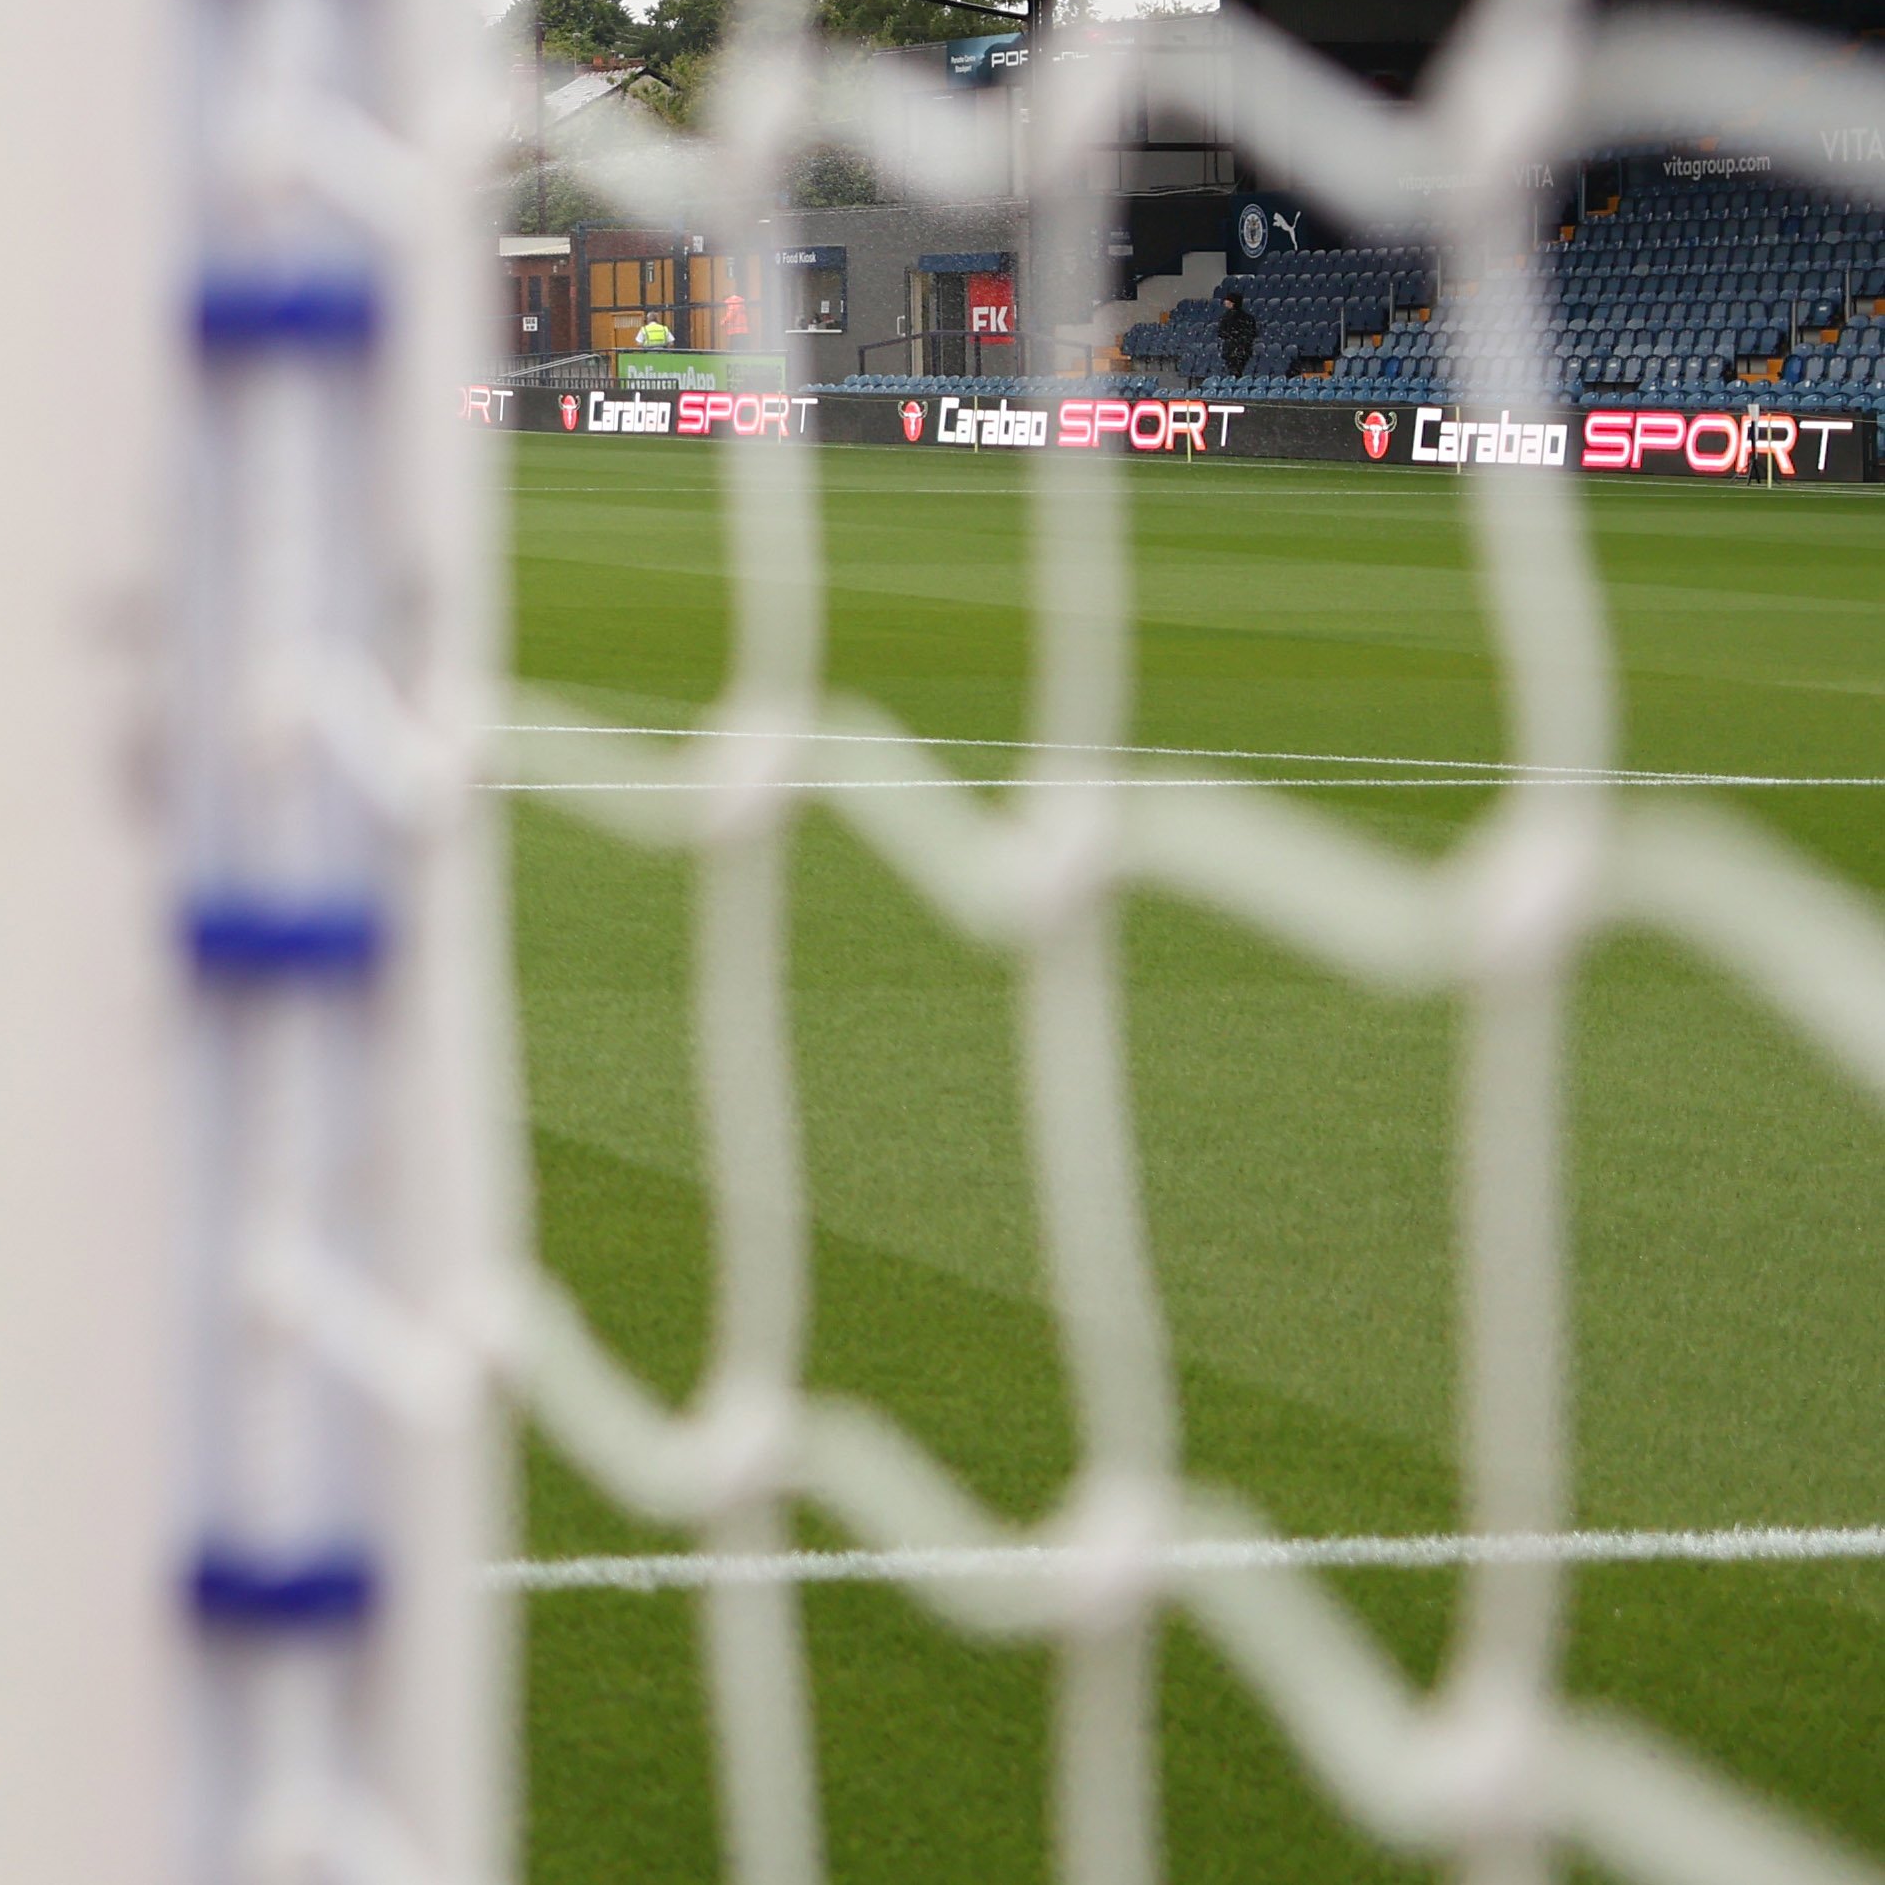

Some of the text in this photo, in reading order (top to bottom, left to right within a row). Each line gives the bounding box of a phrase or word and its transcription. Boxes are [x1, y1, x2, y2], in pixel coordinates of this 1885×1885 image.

[1512, 162, 1554, 189] VITA
[1663, 154, 1771, 181] vitagroup.com
[782, 251, 817, 264] Food Kiosk
[588, 391, 819, 436] Carabao SPORT
[937, 397, 1246, 451] Carabao SPORT
[1411, 407, 1854, 476] Carabao SPORT
